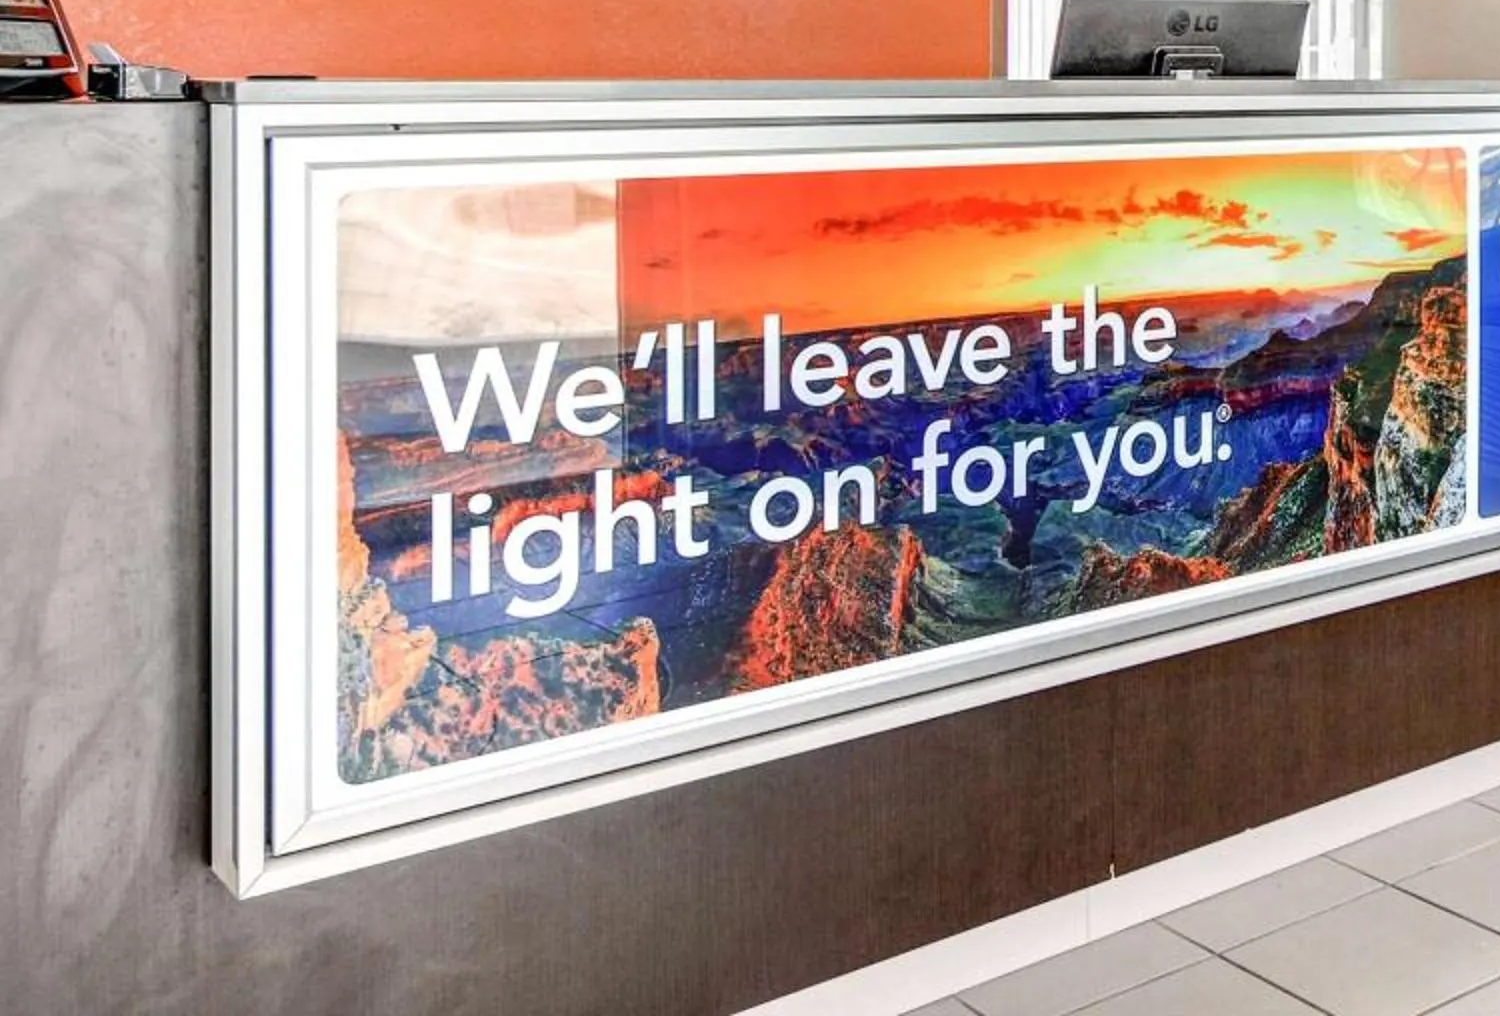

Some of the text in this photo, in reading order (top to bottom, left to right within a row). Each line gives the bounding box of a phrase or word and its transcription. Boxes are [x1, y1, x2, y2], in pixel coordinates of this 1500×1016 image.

[1194, 15, 1219, 33] LG
[412, 284, 1178, 454] We'll leave the
[431, 469, 710, 619] light
[749, 464, 876, 543] on
[912, 418, 1046, 515] for
